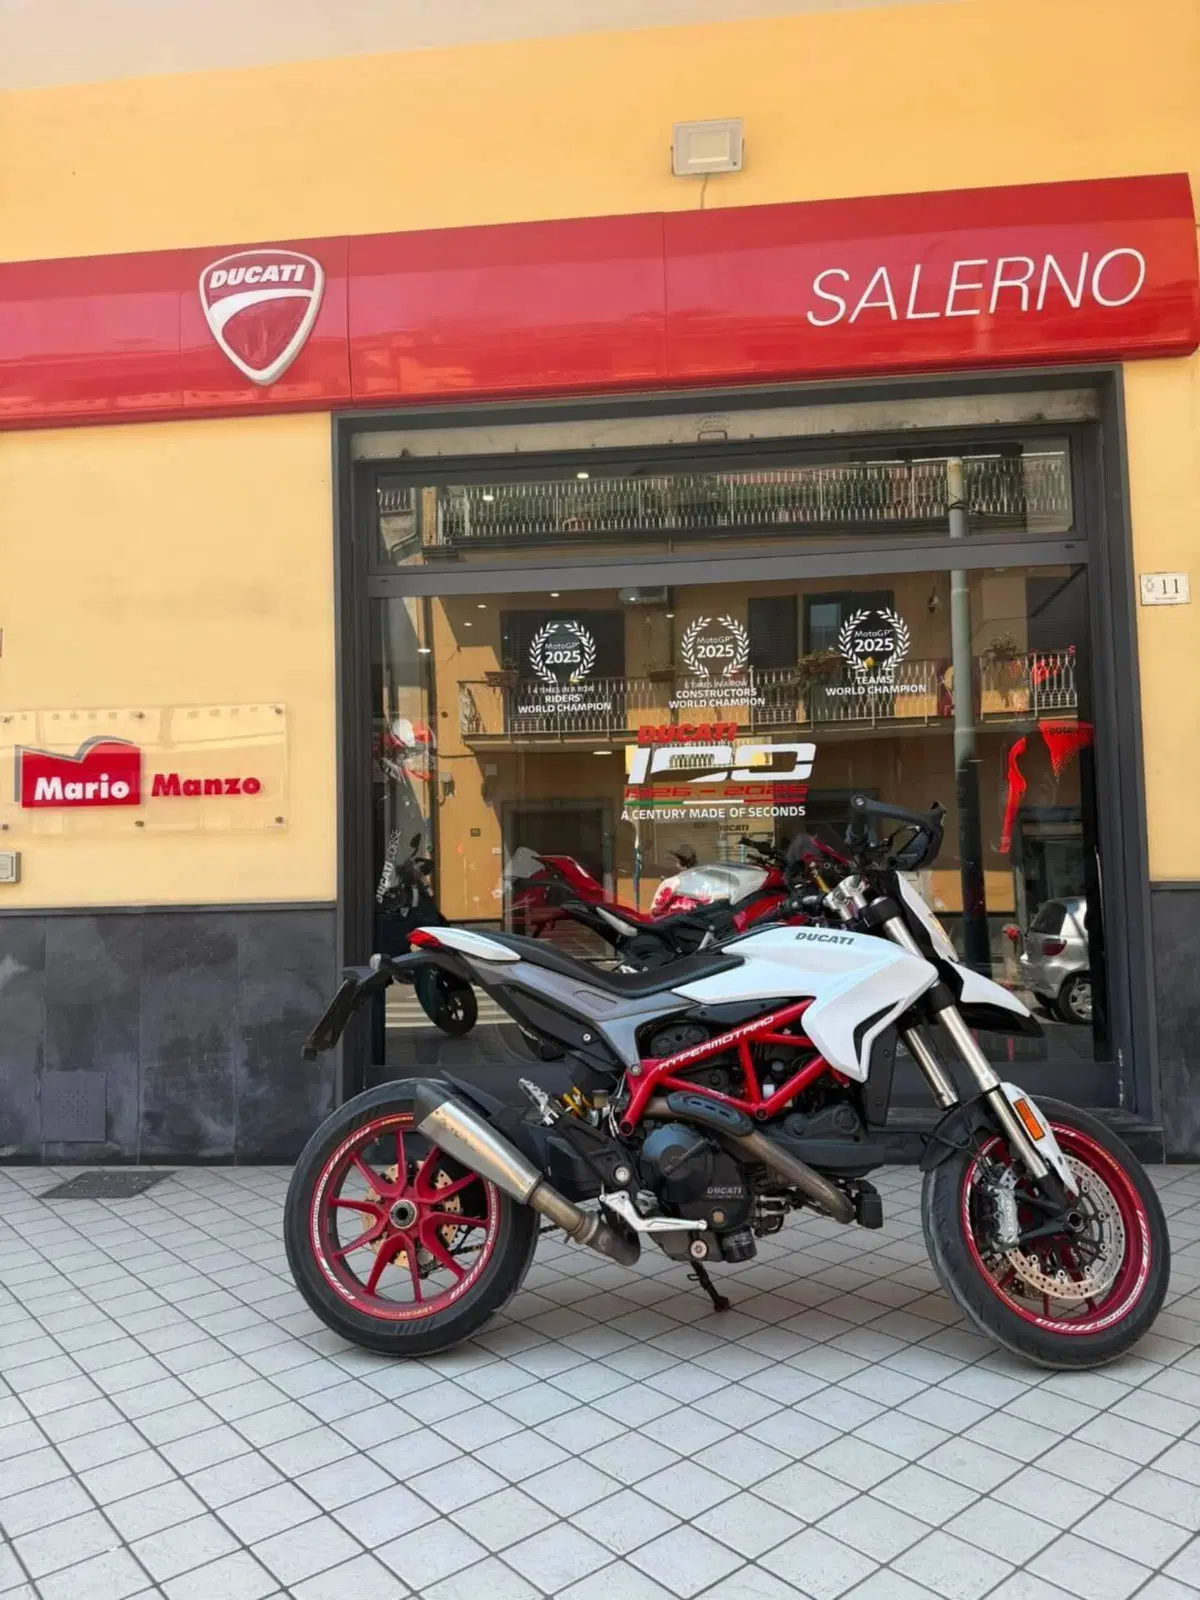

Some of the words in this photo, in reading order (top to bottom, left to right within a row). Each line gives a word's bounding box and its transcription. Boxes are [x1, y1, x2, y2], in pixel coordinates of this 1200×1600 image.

[208, 264, 306, 290] DUCATI
[806, 247, 1146, 328] SALERNO
[1162, 578, 1179, 595] 11
[697, 644, 734, 658] 2025
[854, 637, 894, 653] 2025
[545, 650, 581, 664] 2025
[825, 685, 865, 697] WORLD
[867, 683, 927, 695] CHAMPION
[518, 704, 555, 714] WORLD
[556, 702, 612, 712] CHAMPION
[668, 699, 707, 709] WORLD
[709, 697, 765, 708] CHAMPION
[637, 722, 738, 744] DUCATI
[34, 773, 130, 801] Mario
[151, 773, 261, 797] Manzo
[620, 809, 629, 820] A
[632, 808, 686, 820] CENTURY
[689, 808, 725, 819] MADE
[729, 807, 746, 818] OF
[748, 805, 806, 817] SECONDS
[716, 823, 749, 832] UCATI
[375, 862, 394, 904] DUCATI
[794, 931, 855, 945] DUCATI
[658, 1015, 775, 1070] HYPERMOTARD
[706, 1186, 743, 1195] DUCATI
